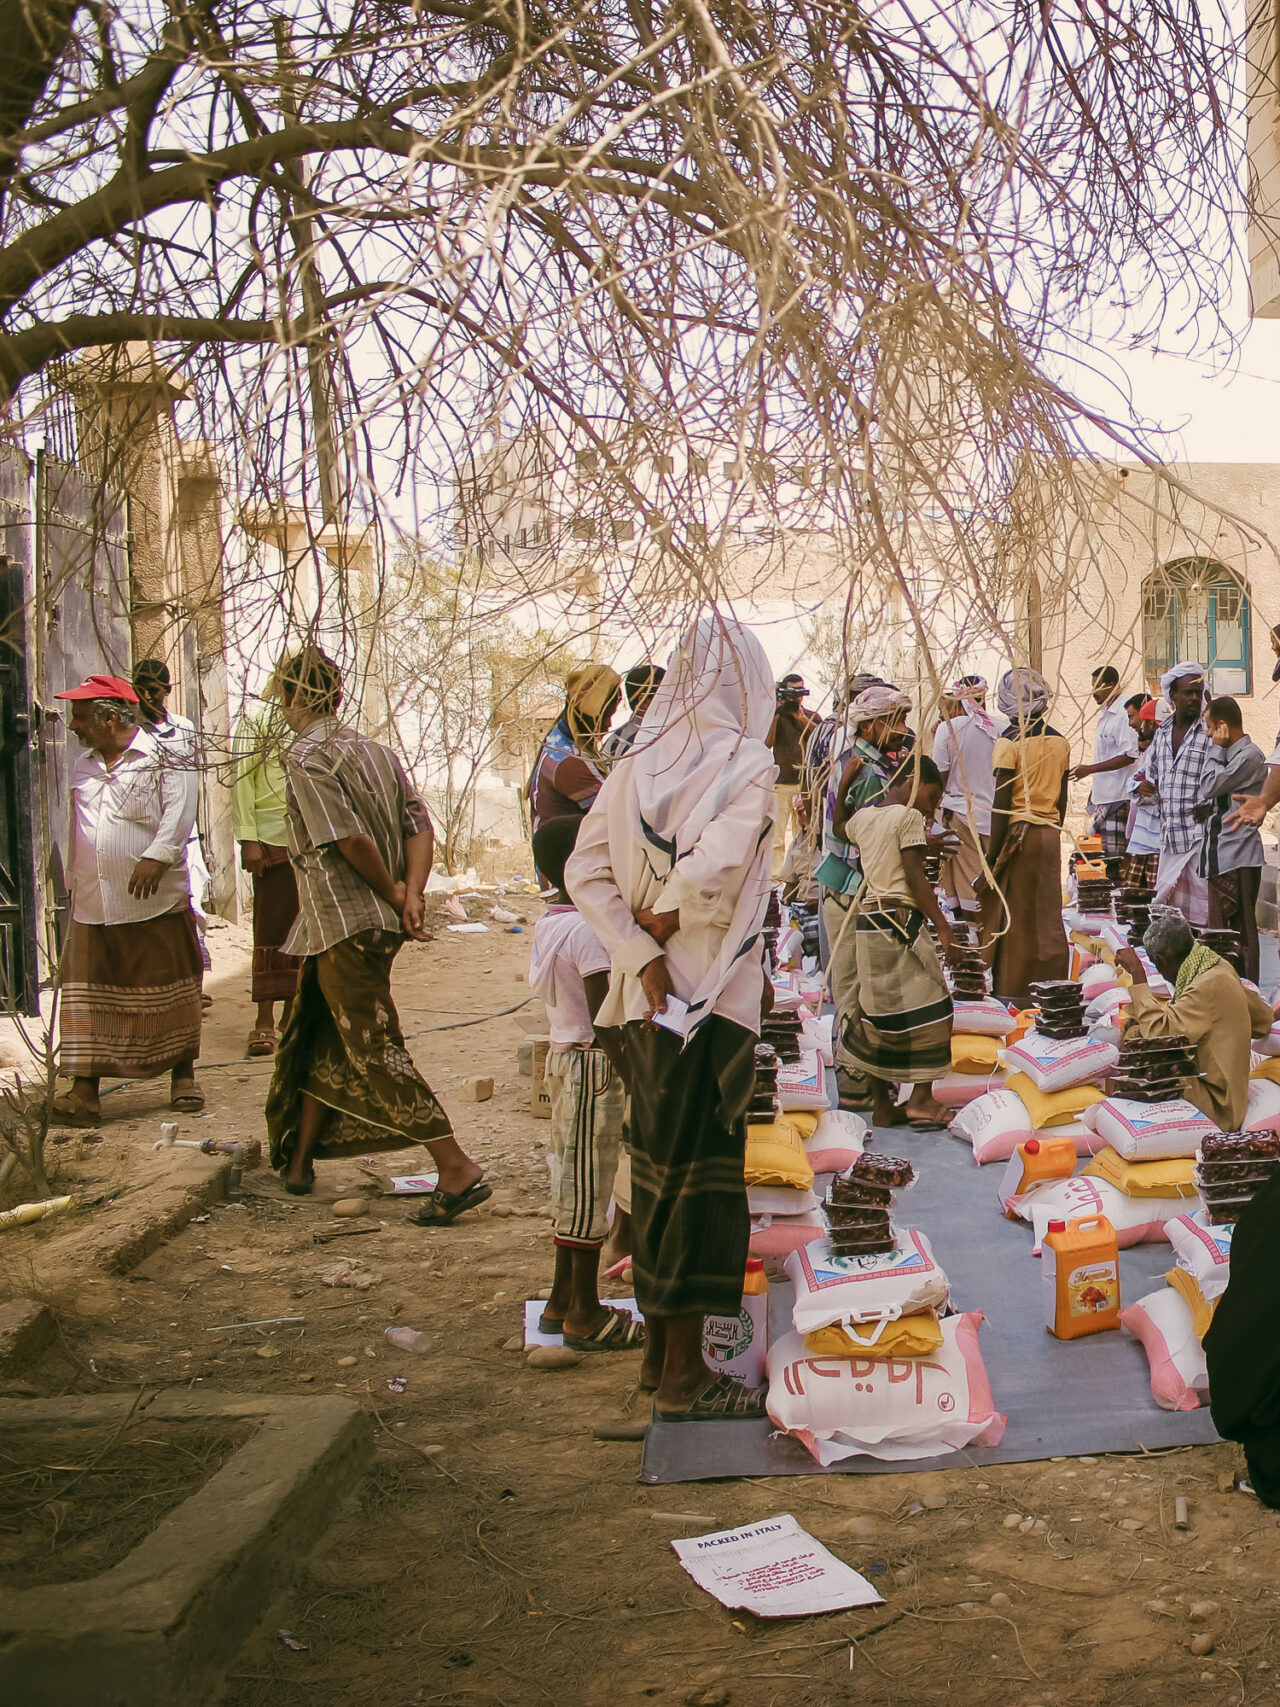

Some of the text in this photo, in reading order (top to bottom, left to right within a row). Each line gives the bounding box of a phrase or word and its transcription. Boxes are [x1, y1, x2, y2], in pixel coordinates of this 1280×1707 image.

[697, 1524, 783, 1549] PACKED IN ITALY
